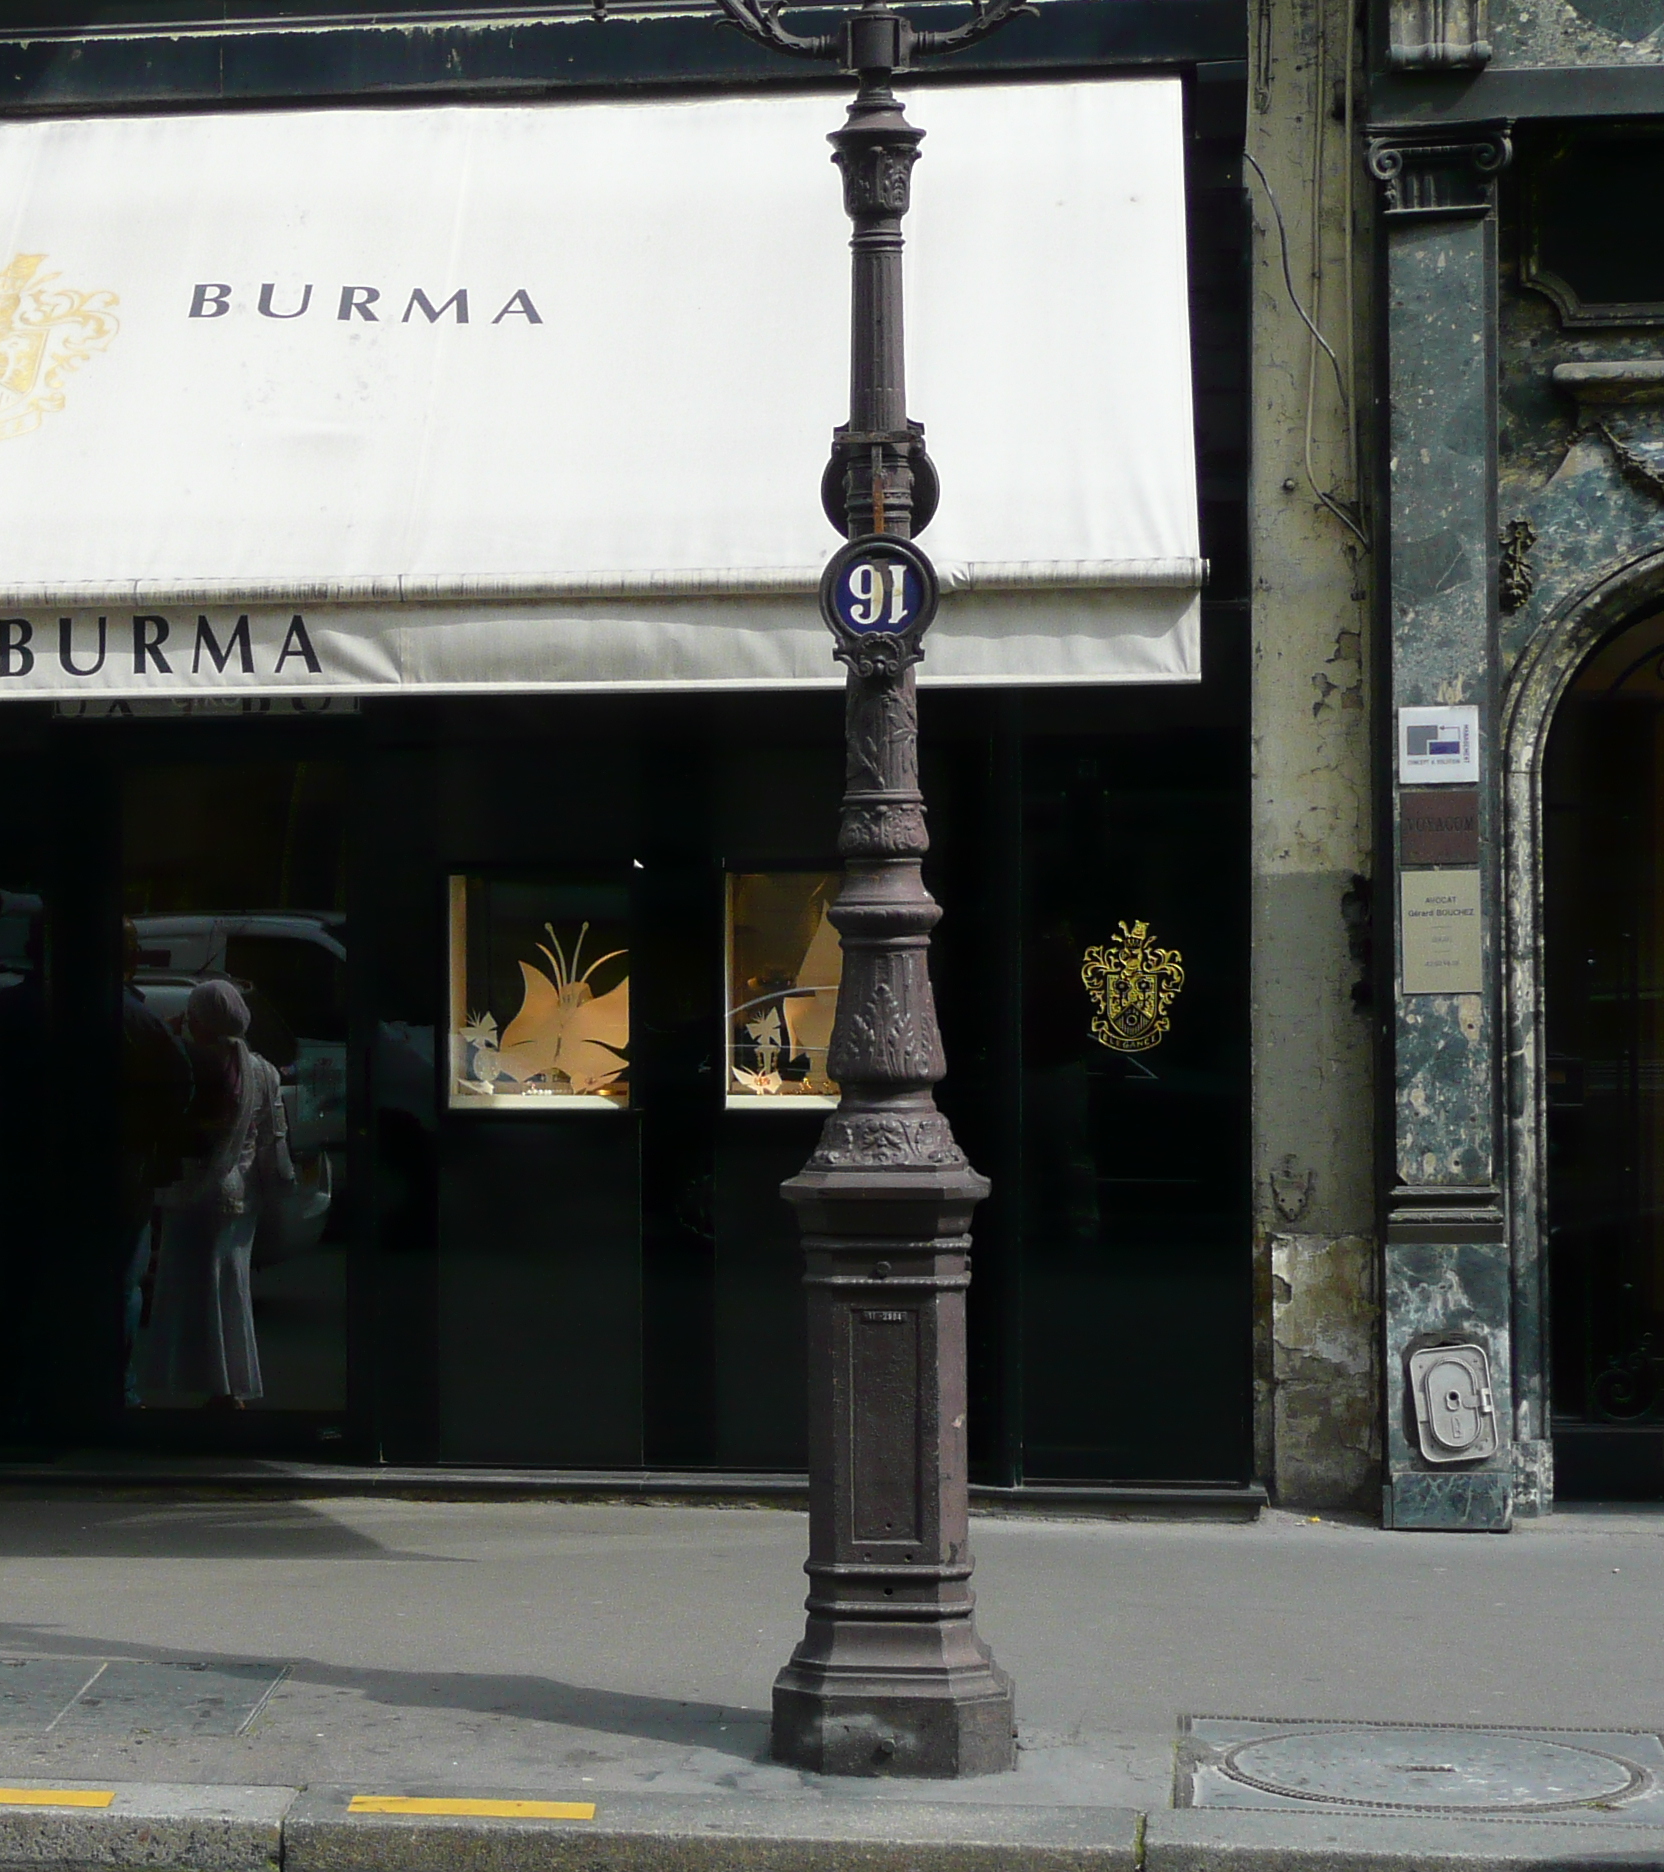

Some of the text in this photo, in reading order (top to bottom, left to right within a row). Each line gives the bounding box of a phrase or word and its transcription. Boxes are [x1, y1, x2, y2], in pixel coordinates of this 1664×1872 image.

[188, 283, 544, 325] BURMA
[1425, 896, 1456, 904] AVOCAT
[1436, 908, 1474, 917] BOUCHEZ
[1102, 1033, 1156, 1049] ELEGANCE
